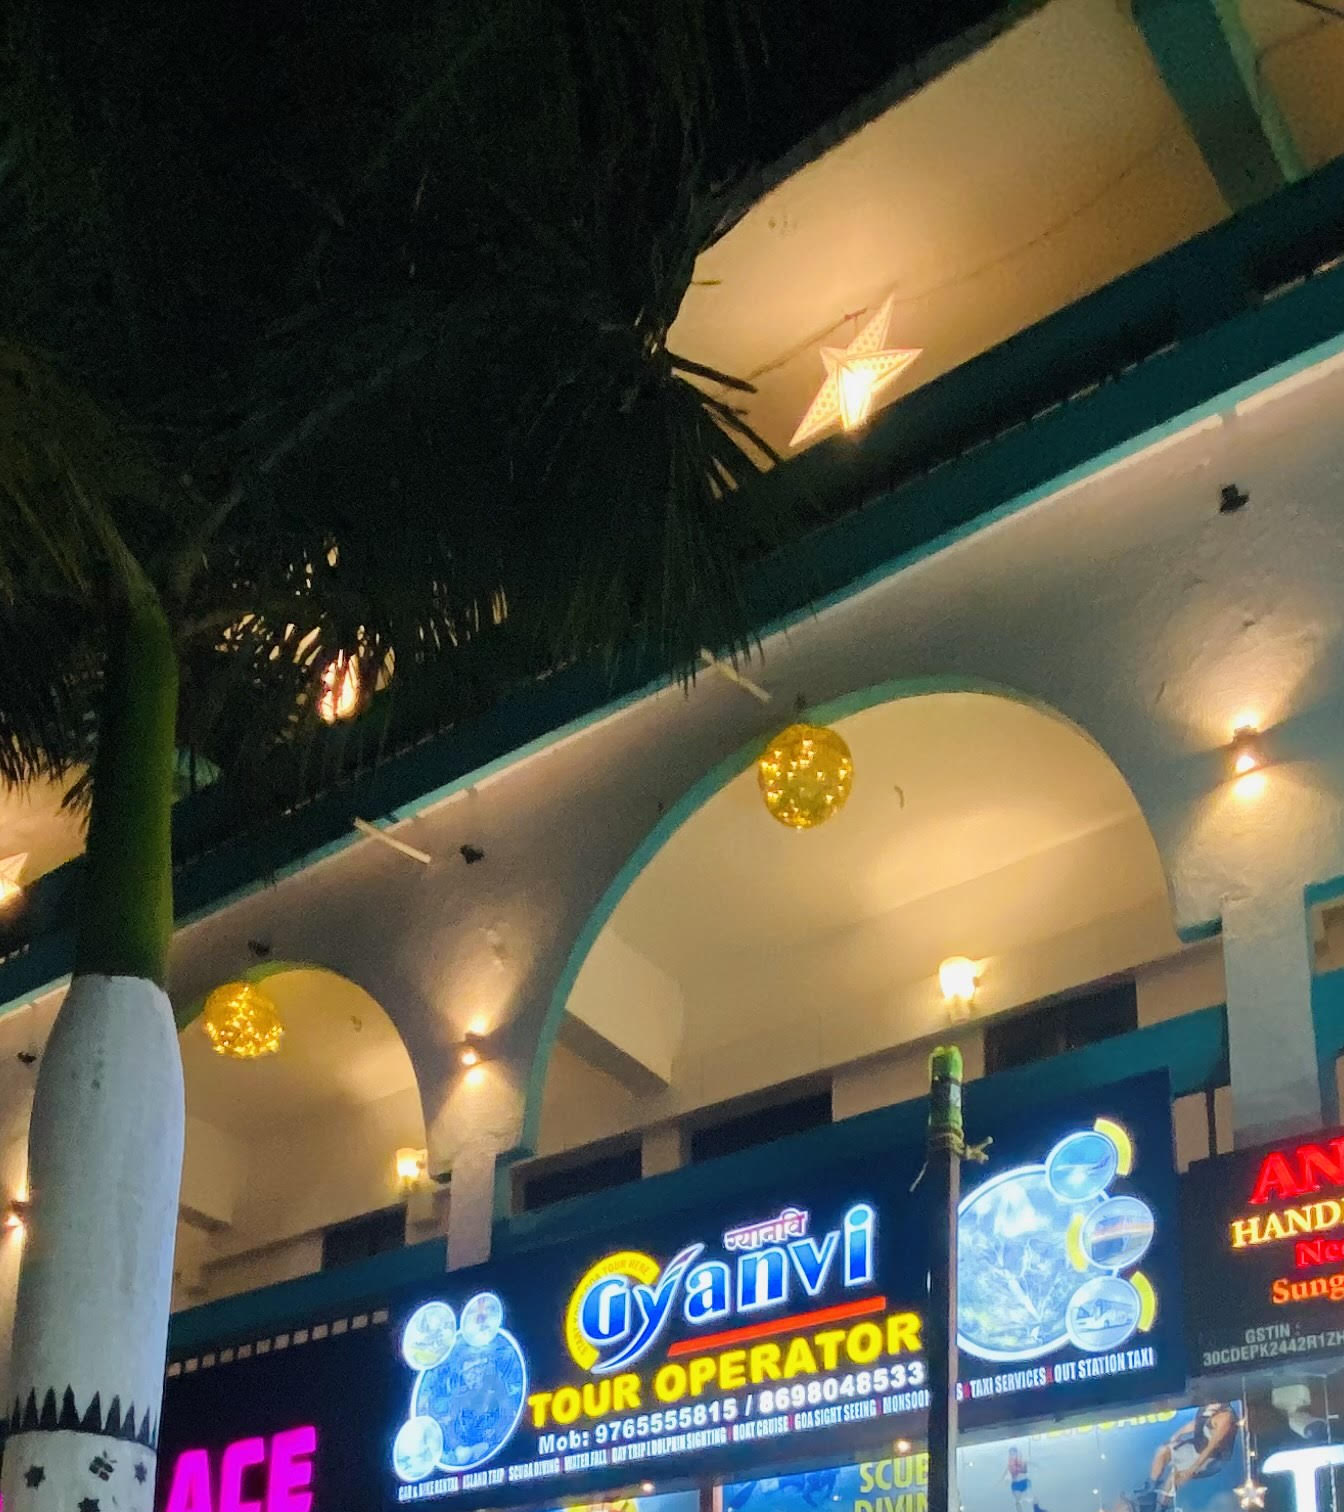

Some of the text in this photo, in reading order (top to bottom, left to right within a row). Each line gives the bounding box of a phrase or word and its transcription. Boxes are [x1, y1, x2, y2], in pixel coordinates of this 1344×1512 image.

[579, 1203, 877, 1374] Gyanvi
[528, 1312, 924, 1429] TOUR OPERATOR
[1245, 1323, 1290, 1345] GSTIN
[539, 1430, 590, 1455] Mob:
[594, 1399, 738, 1445] 9765555815
[759, 1360, 926, 1414] 8698048533
[794, 1410, 814, 1430] GOA
[815, 1404, 842, 1426] SIGHT
[843, 1398, 877, 1421] SEEING
[971, 1376, 994, 1399] TAXI
[995, 1367, 1046, 1393] SERVICES
[1054, 1362, 1077, 1383] OUT
[1078, 1351, 1126, 1378] STATION
[1127, 1346, 1154, 1370] TAXI
[859, 1452, 929, 1494] SCUB
